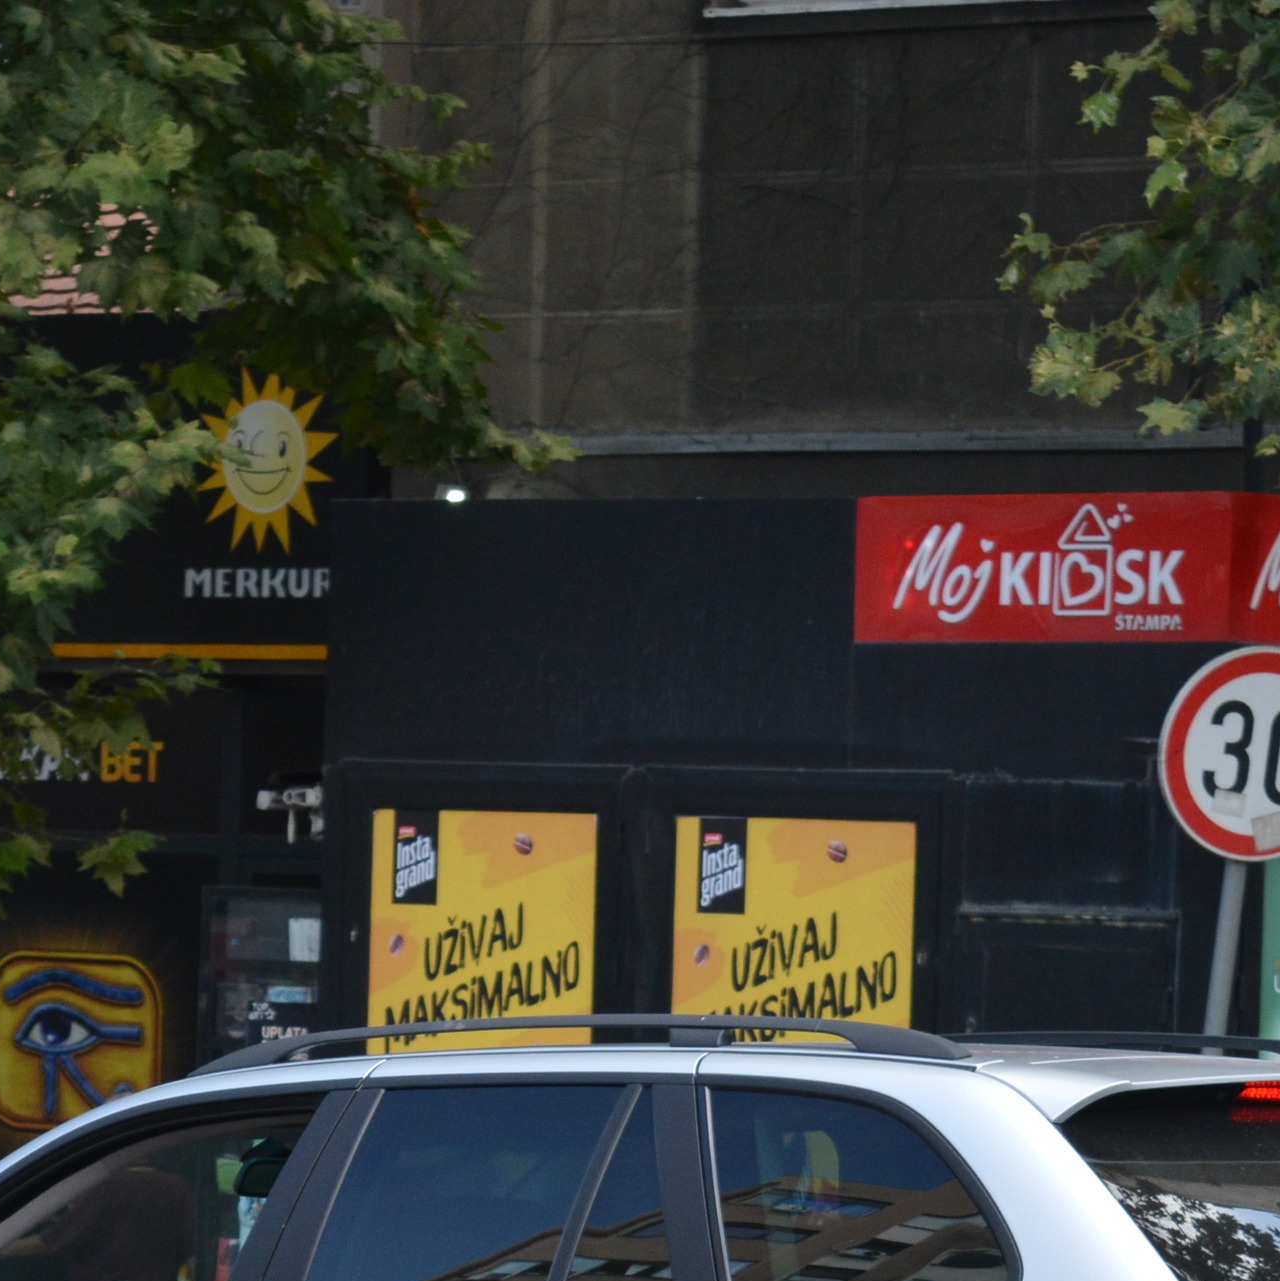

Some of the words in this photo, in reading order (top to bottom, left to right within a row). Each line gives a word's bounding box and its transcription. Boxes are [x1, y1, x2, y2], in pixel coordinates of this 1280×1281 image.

[184, 567, 331, 599] MERKUR
[893, 522, 994, 623] Moj
[1114, 613, 1183, 631] STAMPA
[100, 741, 164, 783] BET
[397, 834, 432, 870] Insta
[701, 841, 741, 878] Insta
[395, 851, 436, 898] grand
[700, 857, 745, 908] grand
[261, 1025, 308, 1039] UPLATA
